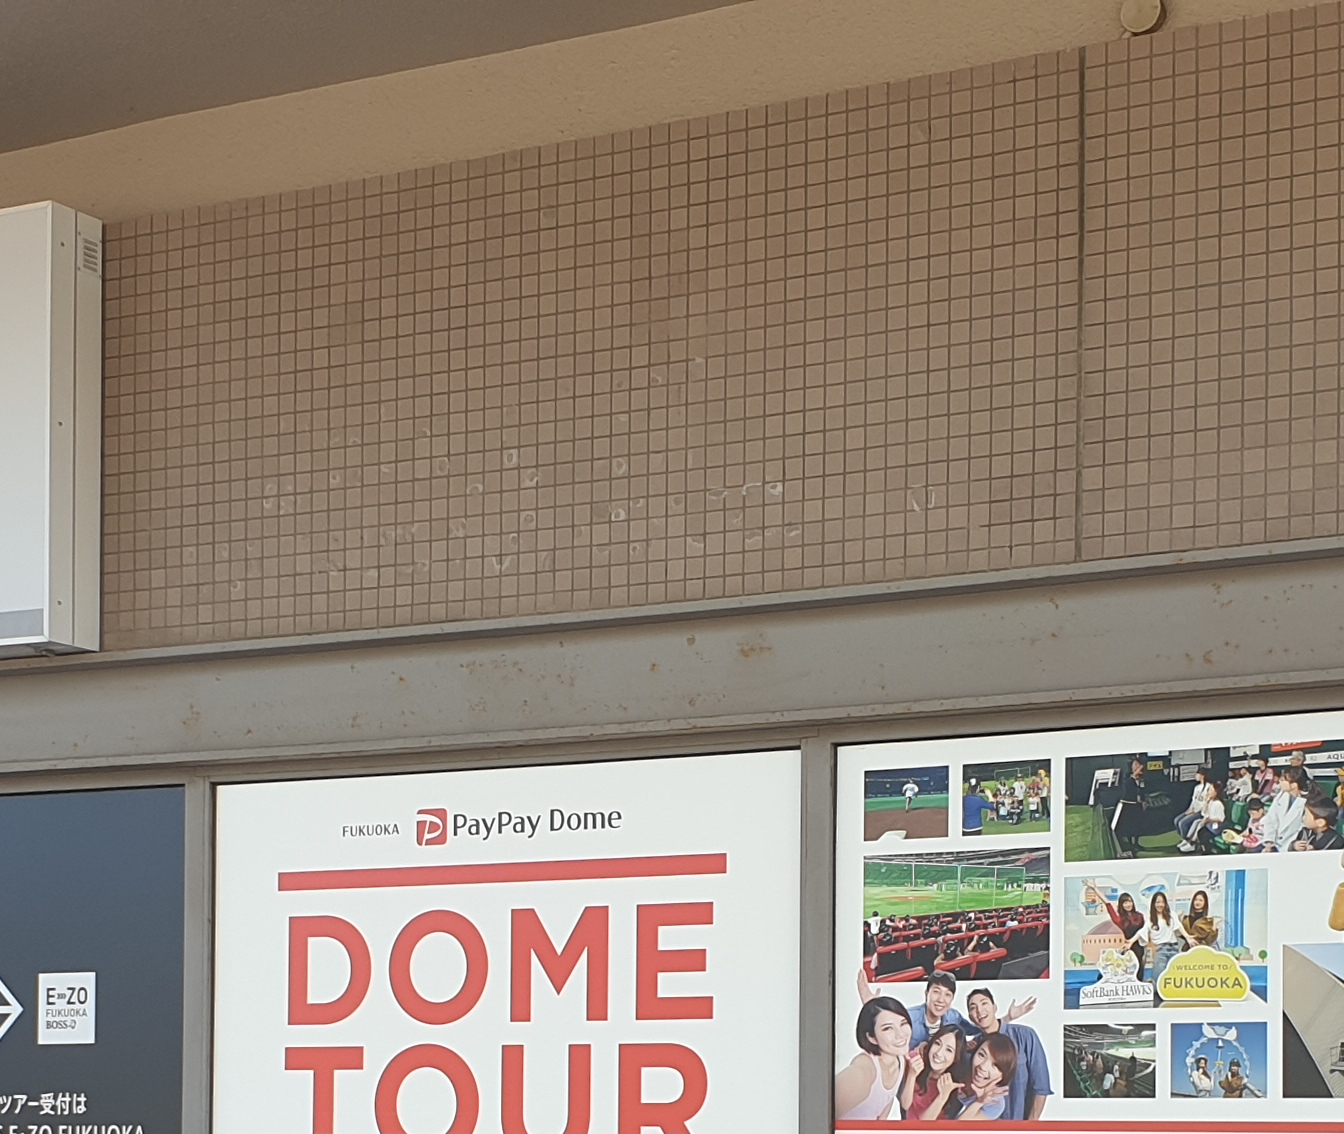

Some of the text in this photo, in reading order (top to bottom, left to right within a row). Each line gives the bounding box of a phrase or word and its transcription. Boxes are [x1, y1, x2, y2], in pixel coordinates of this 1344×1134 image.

[343, 809, 621, 840] FUKUOKA PayPay Dome
[288, 902, 713, 1025] DOME
[1164, 977, 1242, 988] FUKUOKA
[1081, 984, 1152, 999] SoftBank HAWKS
[46, 1008, 87, 1017] FUKUOKA
